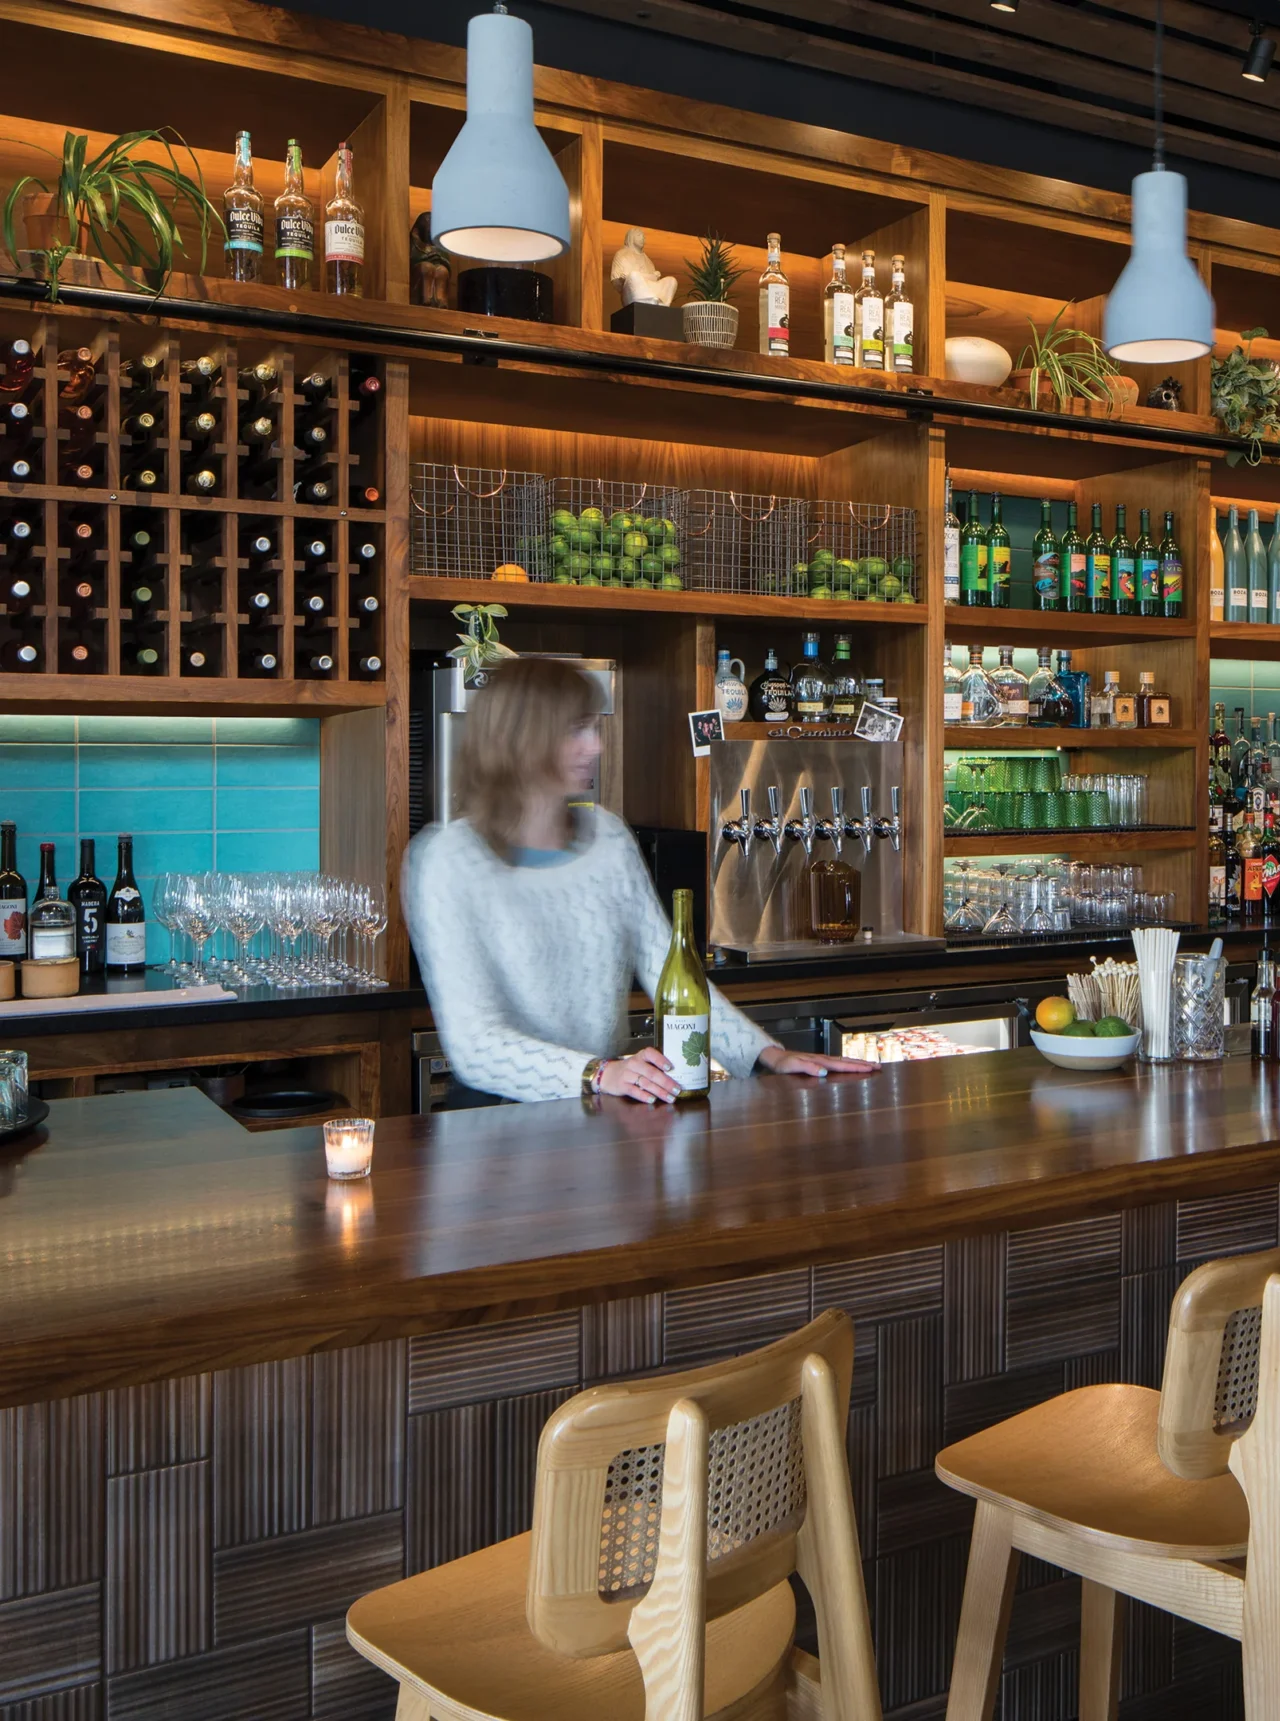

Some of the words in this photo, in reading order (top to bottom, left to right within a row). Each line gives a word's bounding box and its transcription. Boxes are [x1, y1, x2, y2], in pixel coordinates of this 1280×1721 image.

[230, 211, 250, 222] Dulce
[236, 224, 260, 232] TEQUILA
[281, 220, 300, 230] Dulce
[335, 224, 354, 234] Dulce
[286, 232, 310, 240] TEQUILA
[786, 726, 853, 739] Camino
[84, 908, 98, 934] 5
